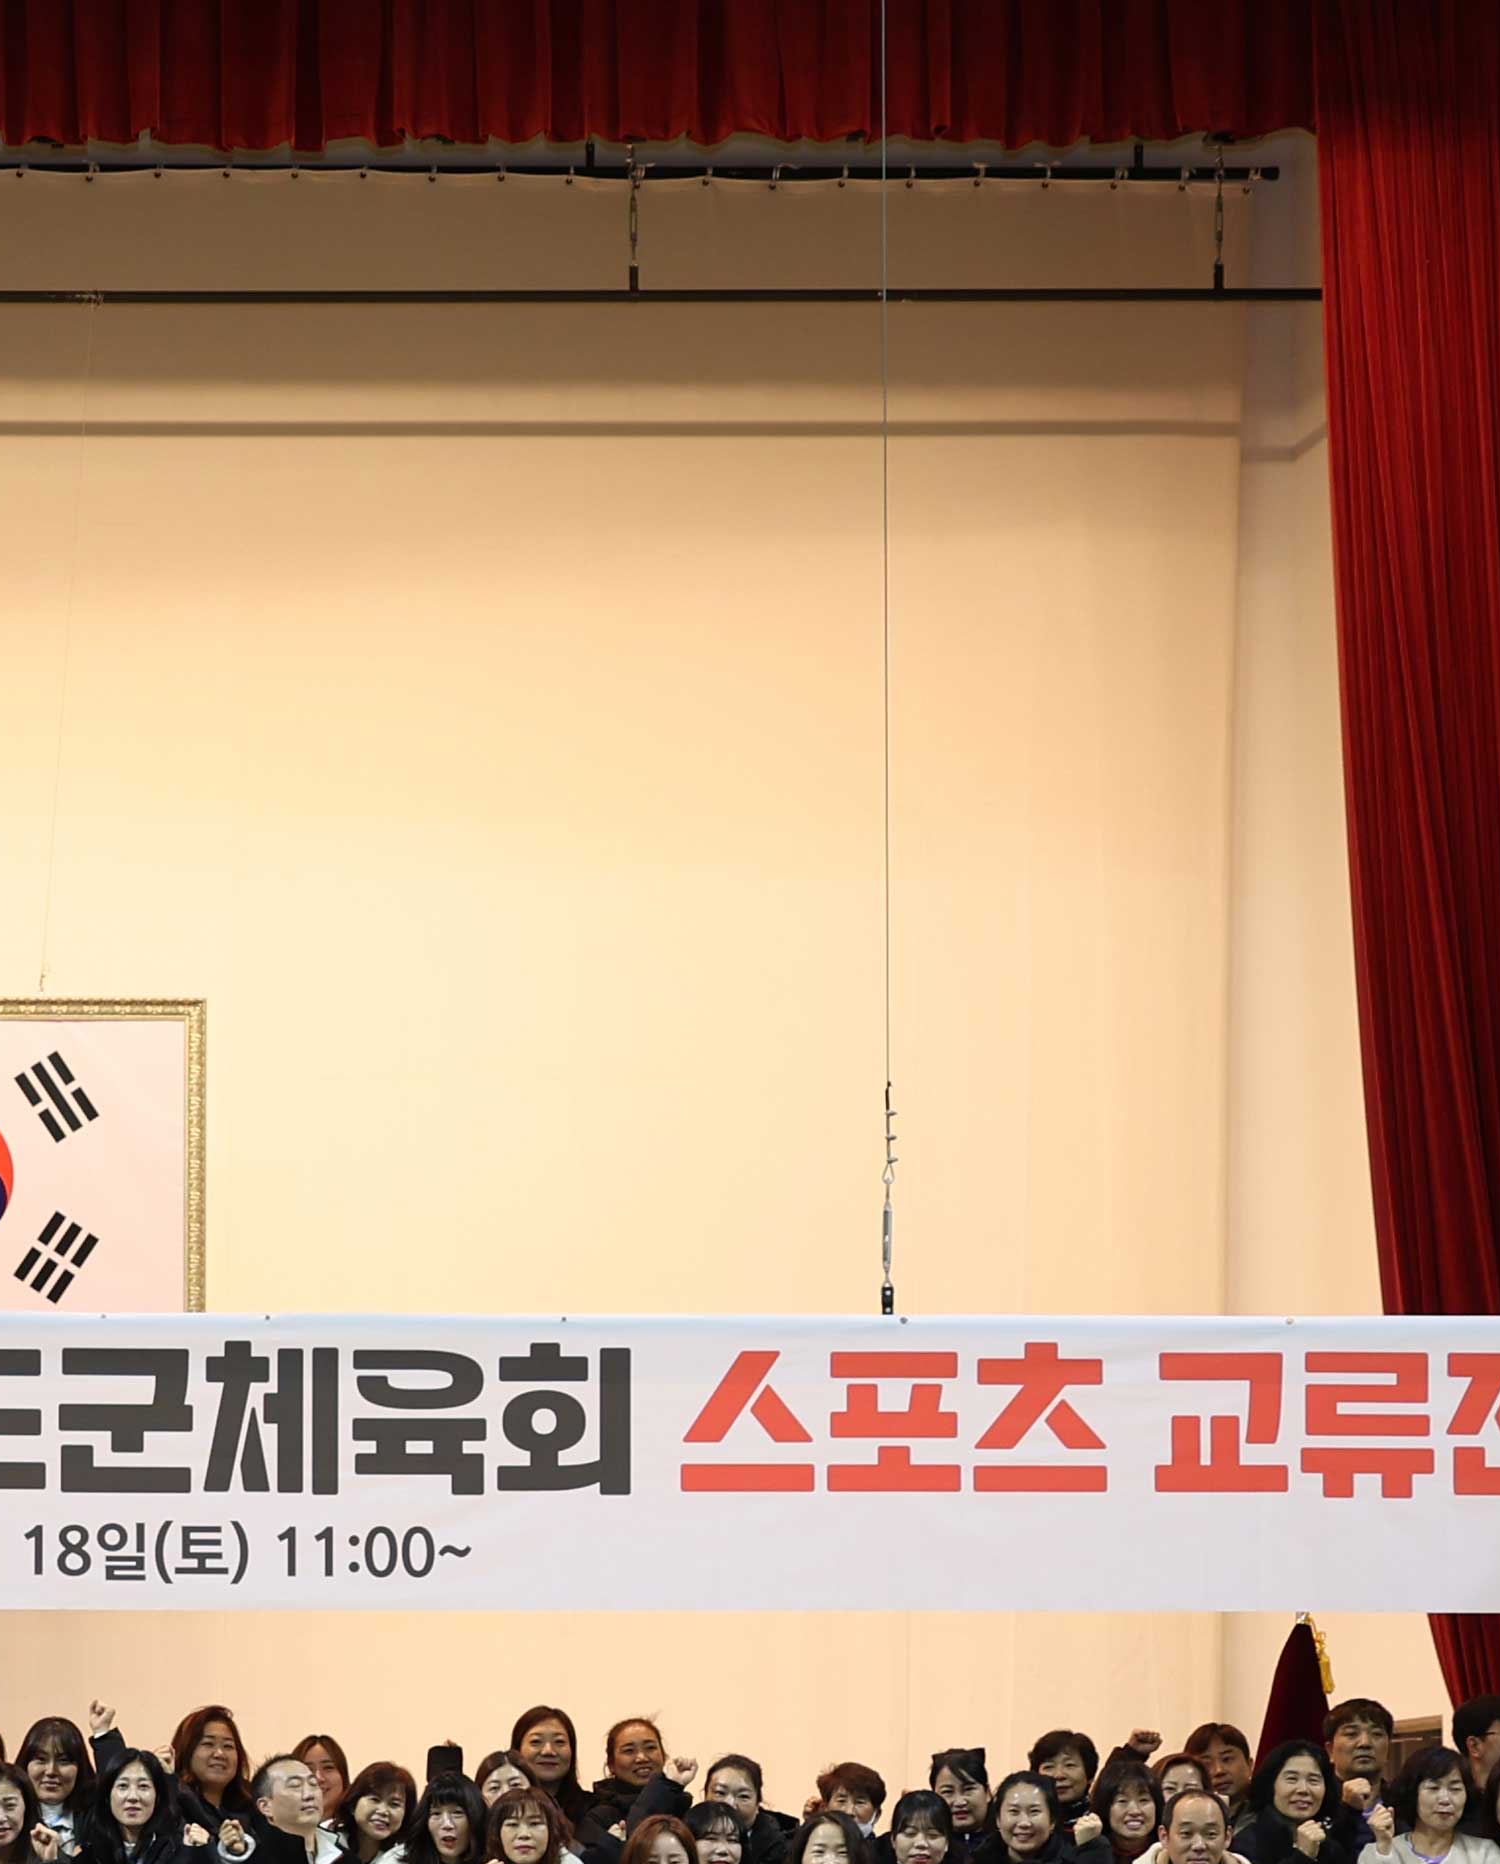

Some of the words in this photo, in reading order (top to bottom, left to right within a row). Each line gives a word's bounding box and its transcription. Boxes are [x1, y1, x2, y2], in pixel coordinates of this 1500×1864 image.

[680, 1342, 1108, 1493] 스포츠
[23, 1519, 250, 1585] 18일(토)
[276, 1525, 473, 1579] 11:00~
